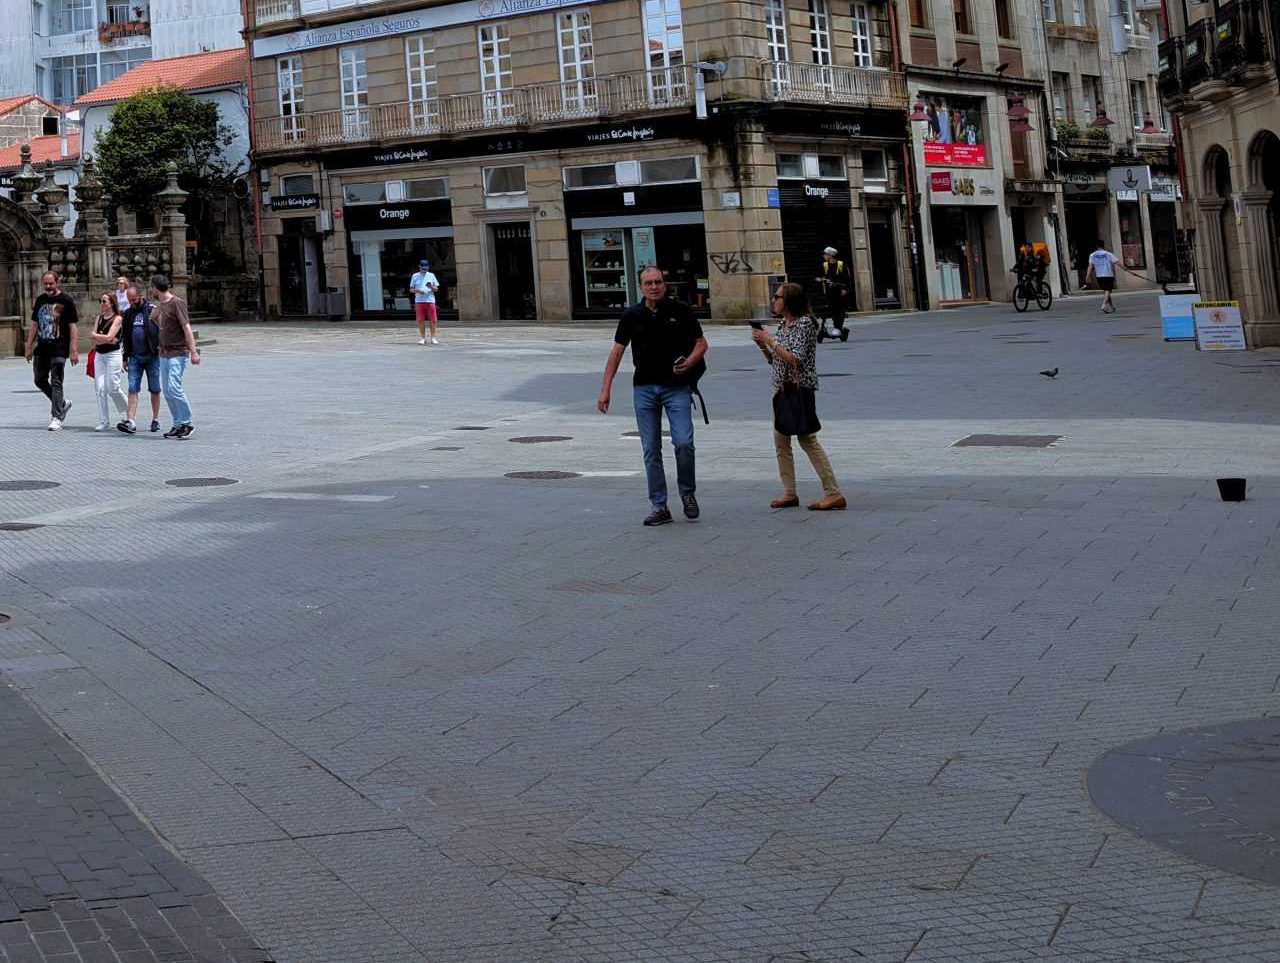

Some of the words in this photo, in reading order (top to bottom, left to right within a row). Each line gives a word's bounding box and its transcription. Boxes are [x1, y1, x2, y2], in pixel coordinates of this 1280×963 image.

[304, 33, 337, 46] Alianza
[339, 23, 379, 40] Española
[382, 17, 421, 34] Seguros
[587, 133, 610, 141] VIAJES
[805, 185, 829, 198] Orange
[380, 208, 410, 220] Orange
